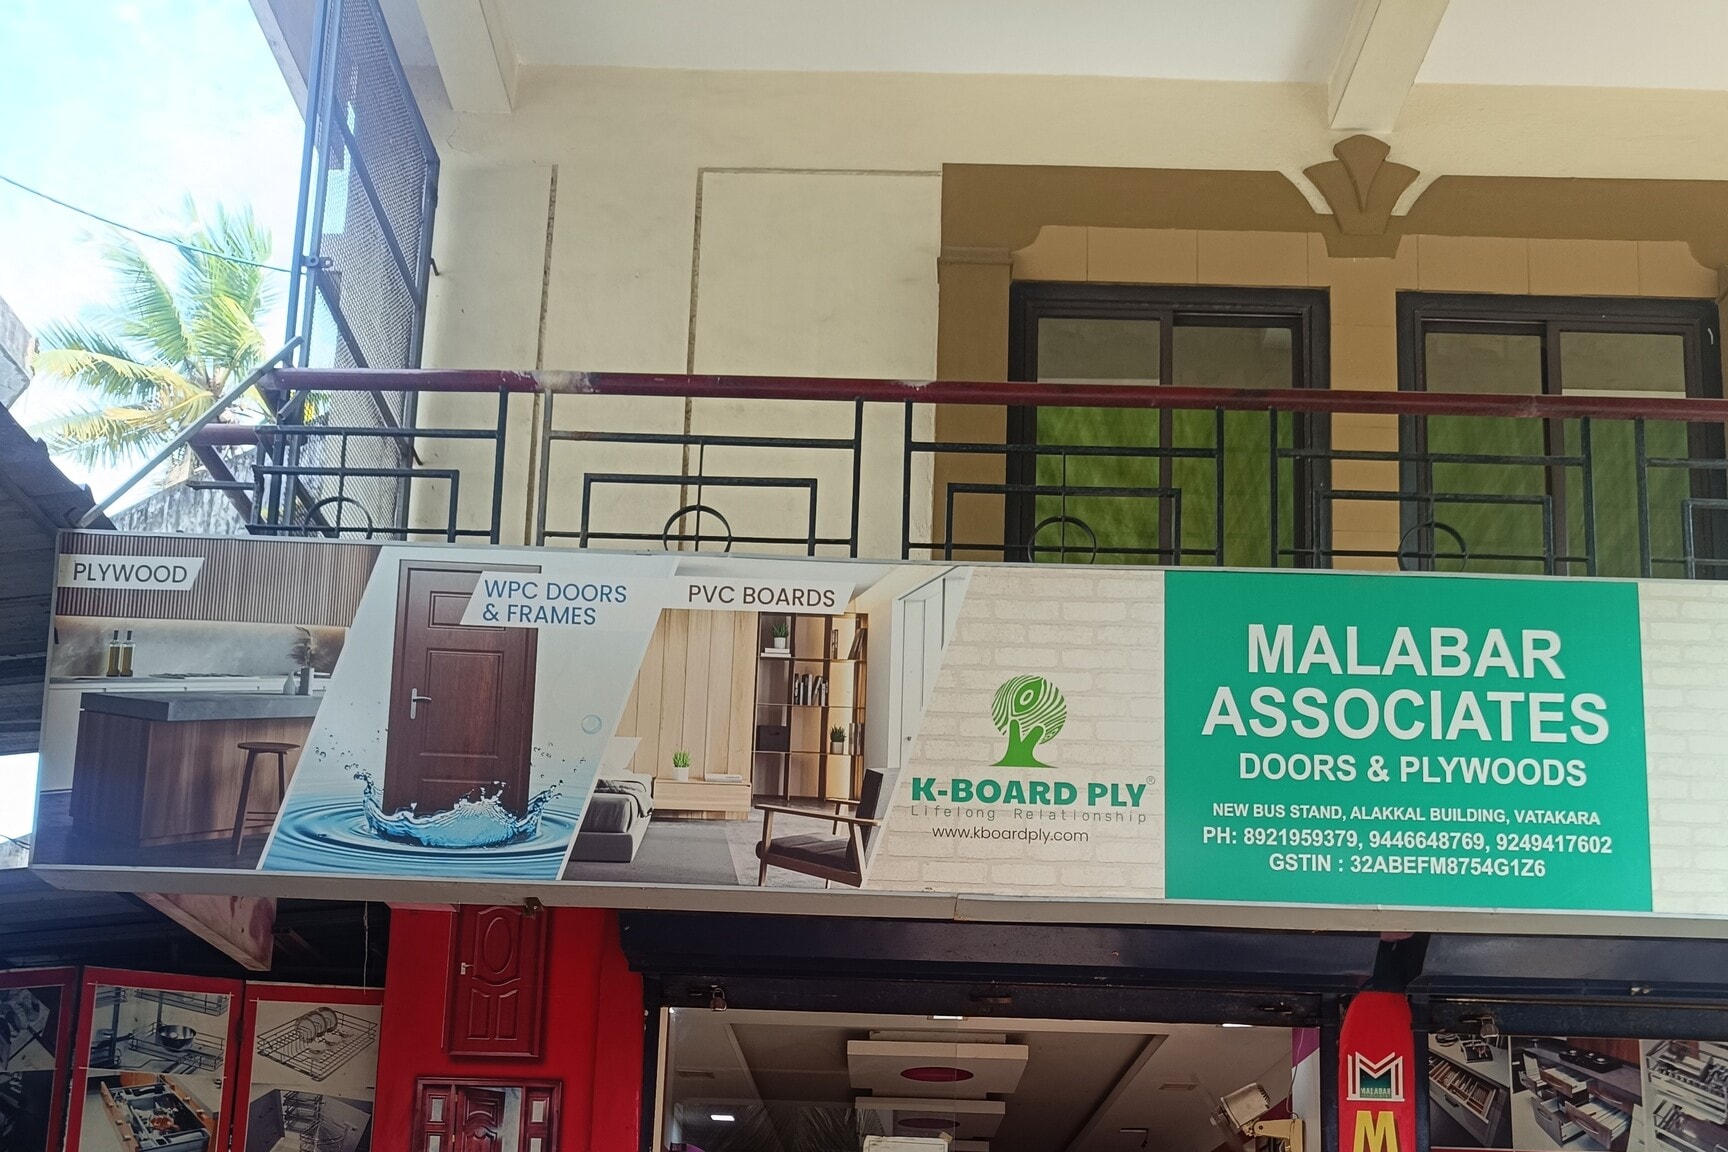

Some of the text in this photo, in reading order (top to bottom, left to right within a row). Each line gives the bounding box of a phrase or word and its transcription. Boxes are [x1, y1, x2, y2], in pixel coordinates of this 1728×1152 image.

[73, 562, 188, 583] PLYWOOD
[484, 579, 628, 603] WPC DOORS
[688, 584, 836, 608] PVC BOARDS
[482, 603, 597, 626] & FRAMES
[1247, 623, 1566, 680] MALABAR
[1201, 686, 1610, 745] ASSOCIATES
[1239, 752, 1588, 788] DOORS & PLYWOODS
[911, 777, 1147, 808] K-BOARD PLY
[910, 805, 1147, 825] Lifelong Relationship
[1213, 803, 1601, 825] NEW BUS STAND, ALAKKAL BUILDING, VATAKARA
[932, 826, 1089, 844] www.kboardply.com
[1203, 826, 1613, 854] PH: 8921959379, 9446648769, 9249417602
[1269, 853, 1332, 872] GSTIN
[1350, 854, 1546, 878] 32ABEFM8754G1Z6
